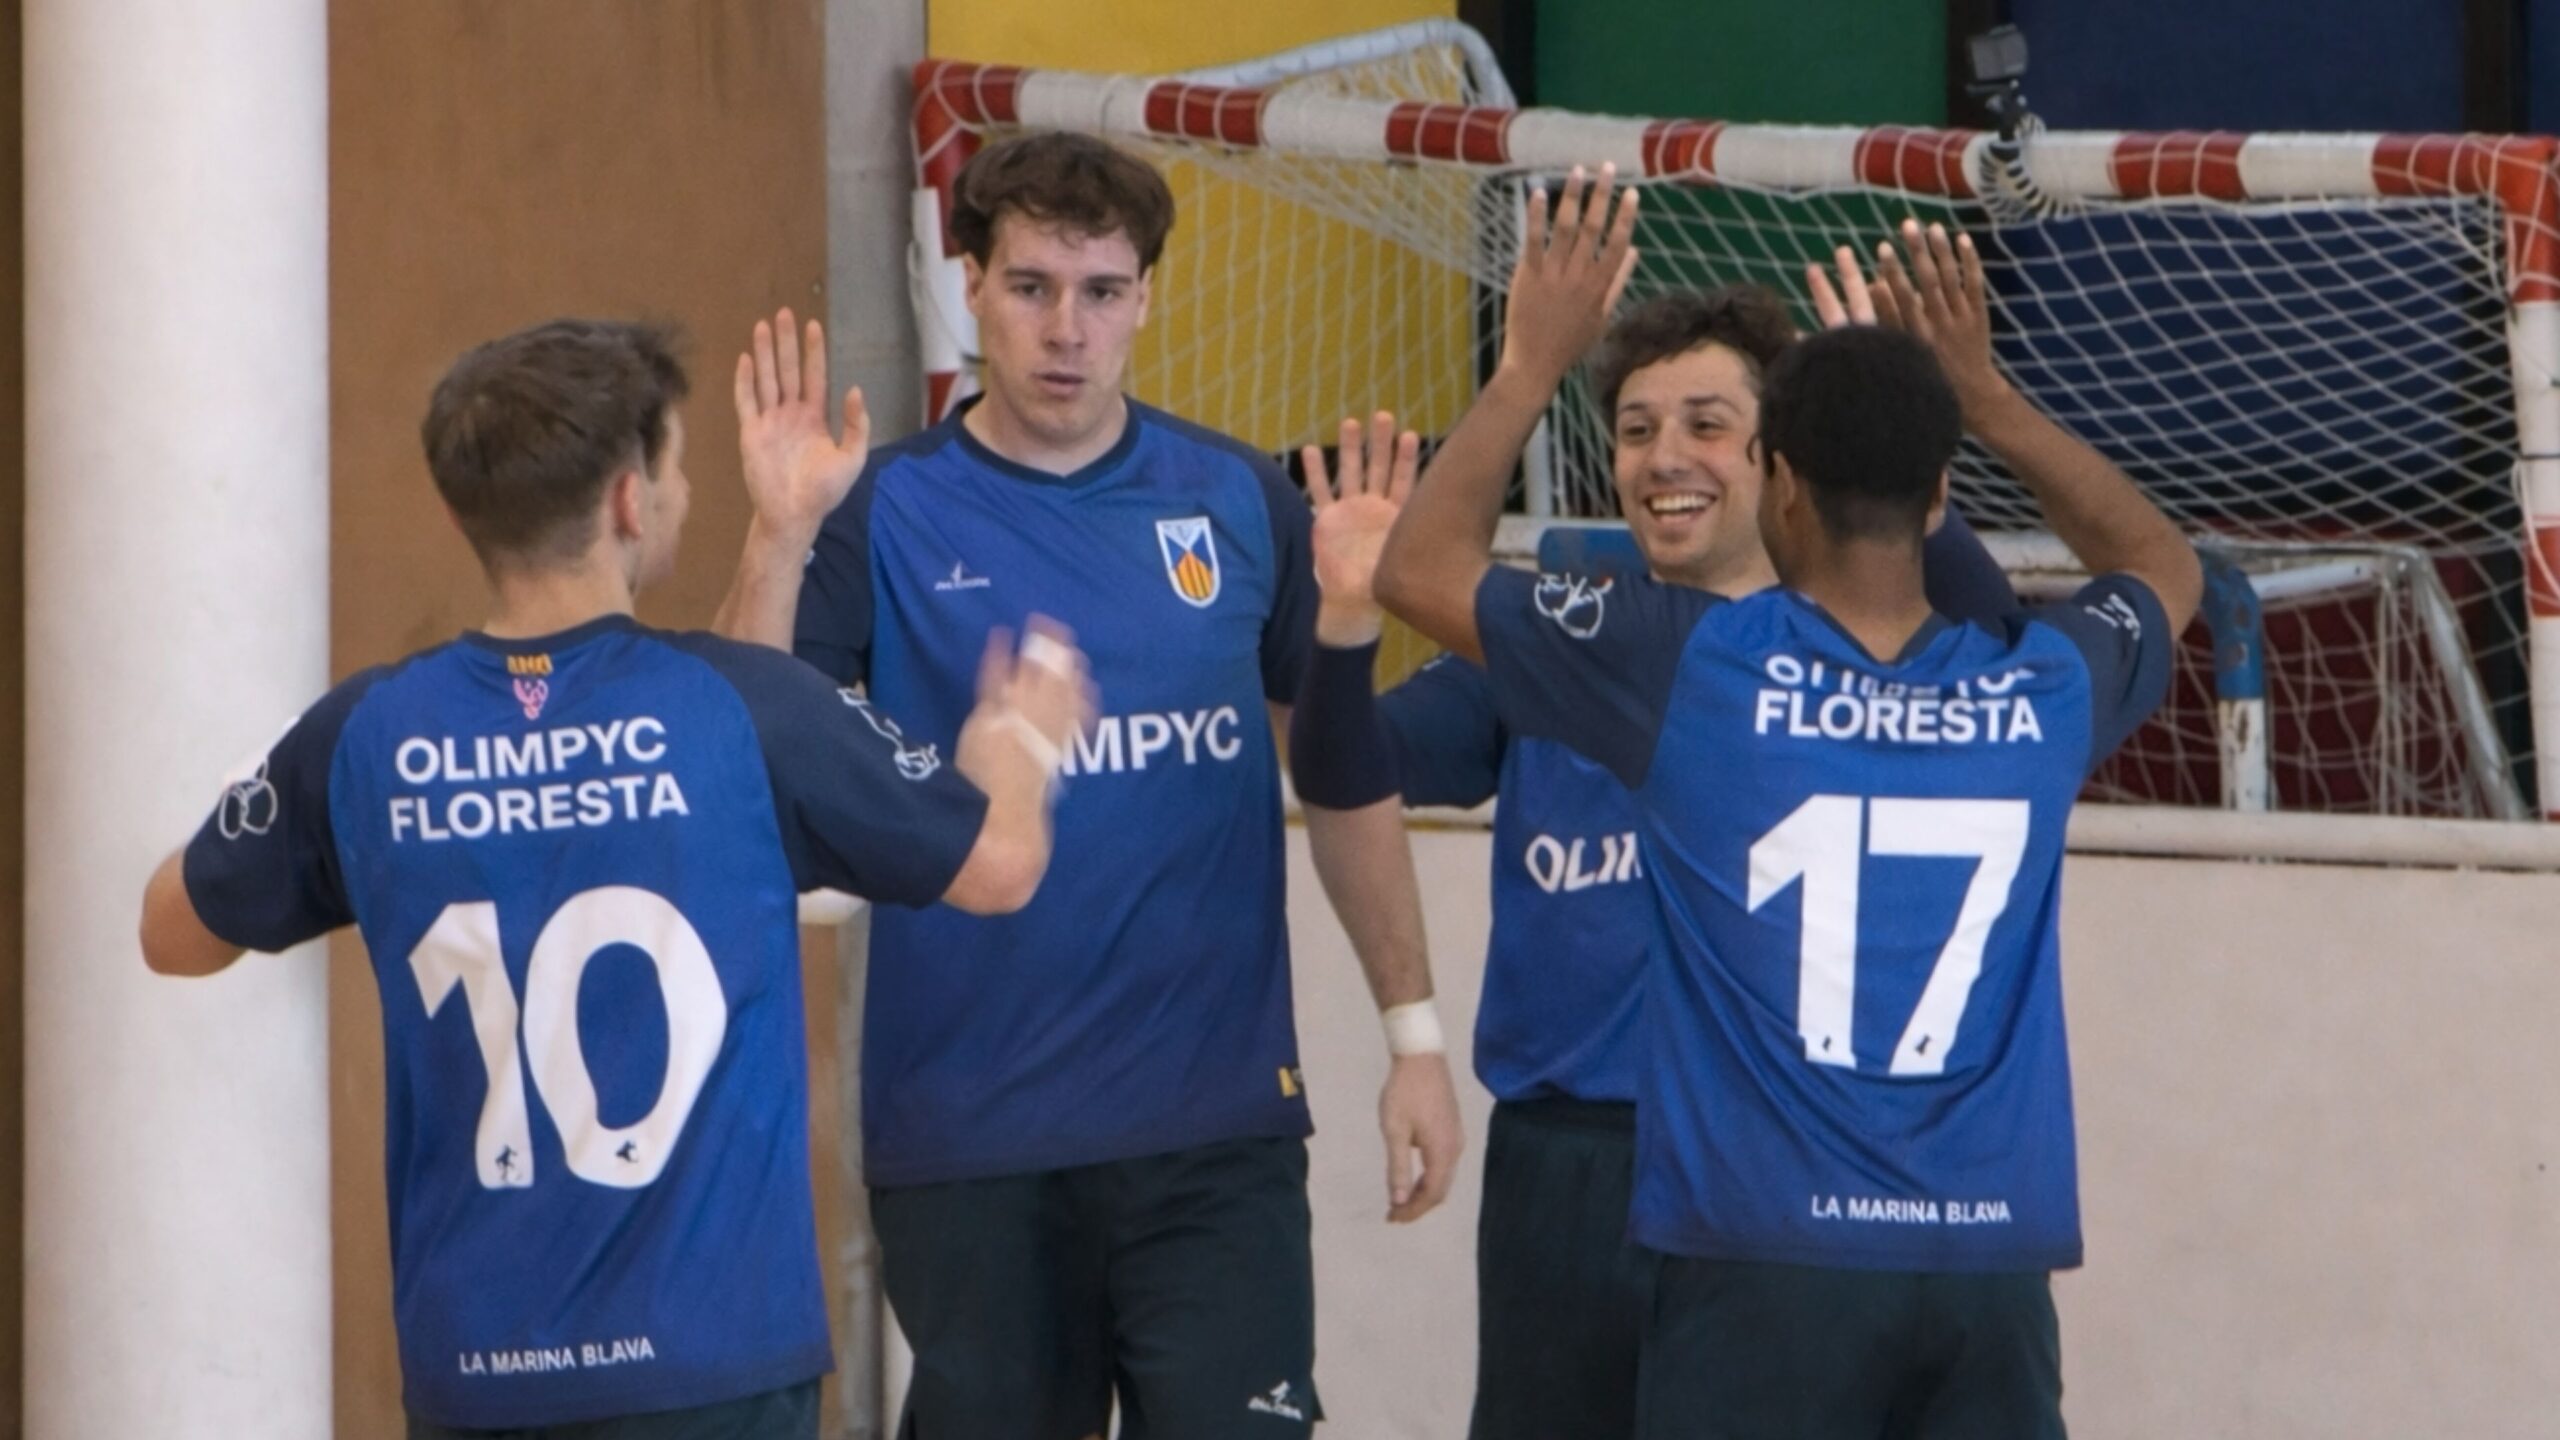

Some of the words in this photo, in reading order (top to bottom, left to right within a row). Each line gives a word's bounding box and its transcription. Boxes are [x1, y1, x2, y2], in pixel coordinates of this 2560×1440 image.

[395, 716, 668, 785] OLIMPYC
[1062, 705, 1243, 777] MPYC
[1755, 688, 2043, 744] FLORESTA
[388, 772, 691, 842] FLORESTA
[1747, 793, 2031, 1076] 17
[407, 884, 728, 1190] 10
[1812, 1195, 1842, 1220] LA
[1848, 1197, 1940, 1223] MARINA
[1946, 1200, 2012, 1224] BLAVA
[459, 1351, 487, 1375] LA
[491, 1346, 577, 1375] MARINA
[581, 1336, 656, 1367] BLAVA
